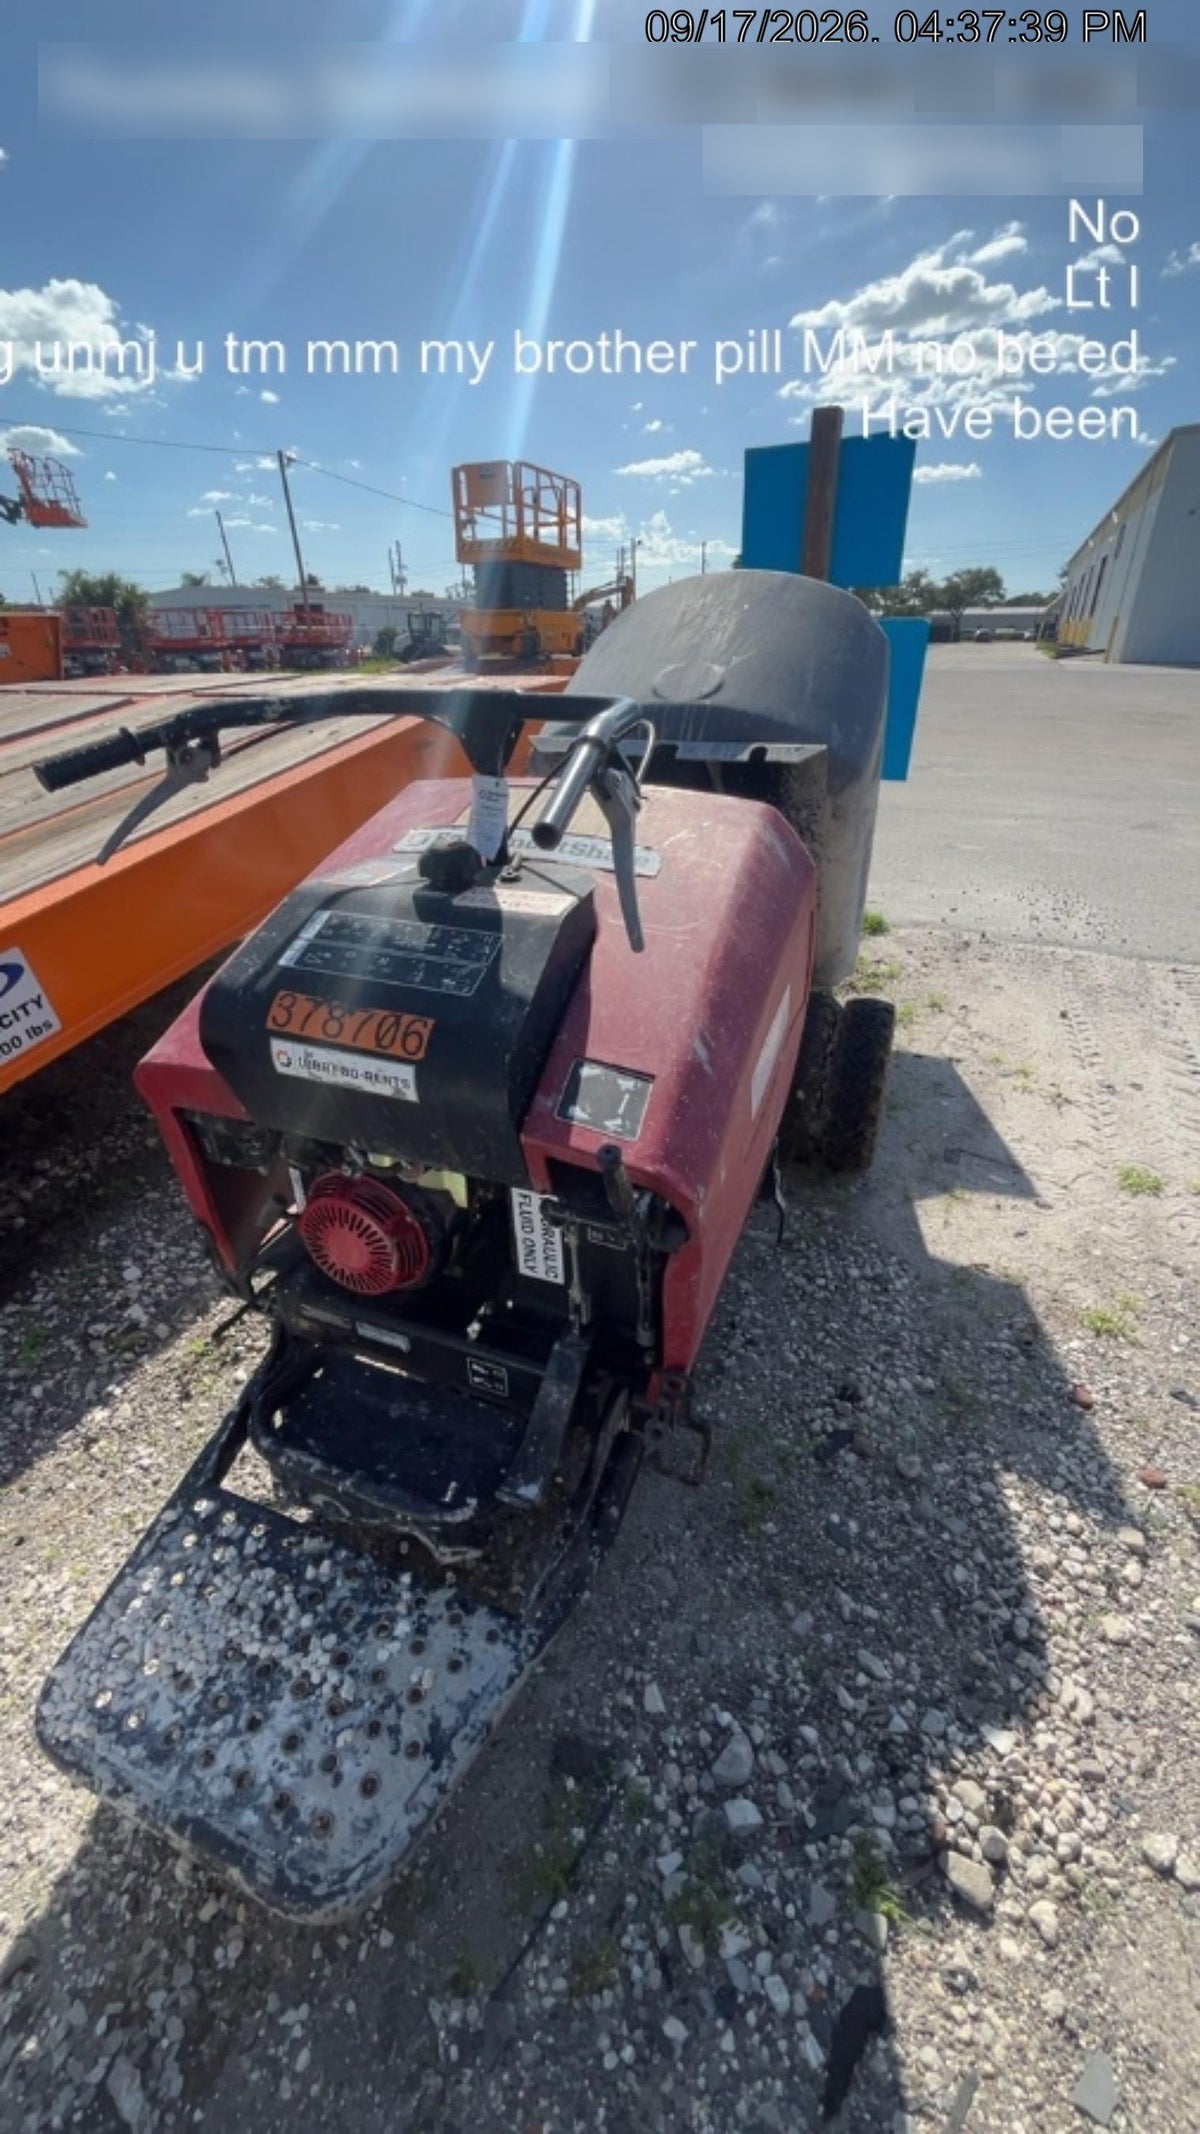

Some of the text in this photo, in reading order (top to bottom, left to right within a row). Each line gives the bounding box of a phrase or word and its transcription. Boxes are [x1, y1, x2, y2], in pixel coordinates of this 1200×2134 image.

[271, 992, 428, 1056] 378706
[519, 1193, 539, 1274] FLUID ONLY
